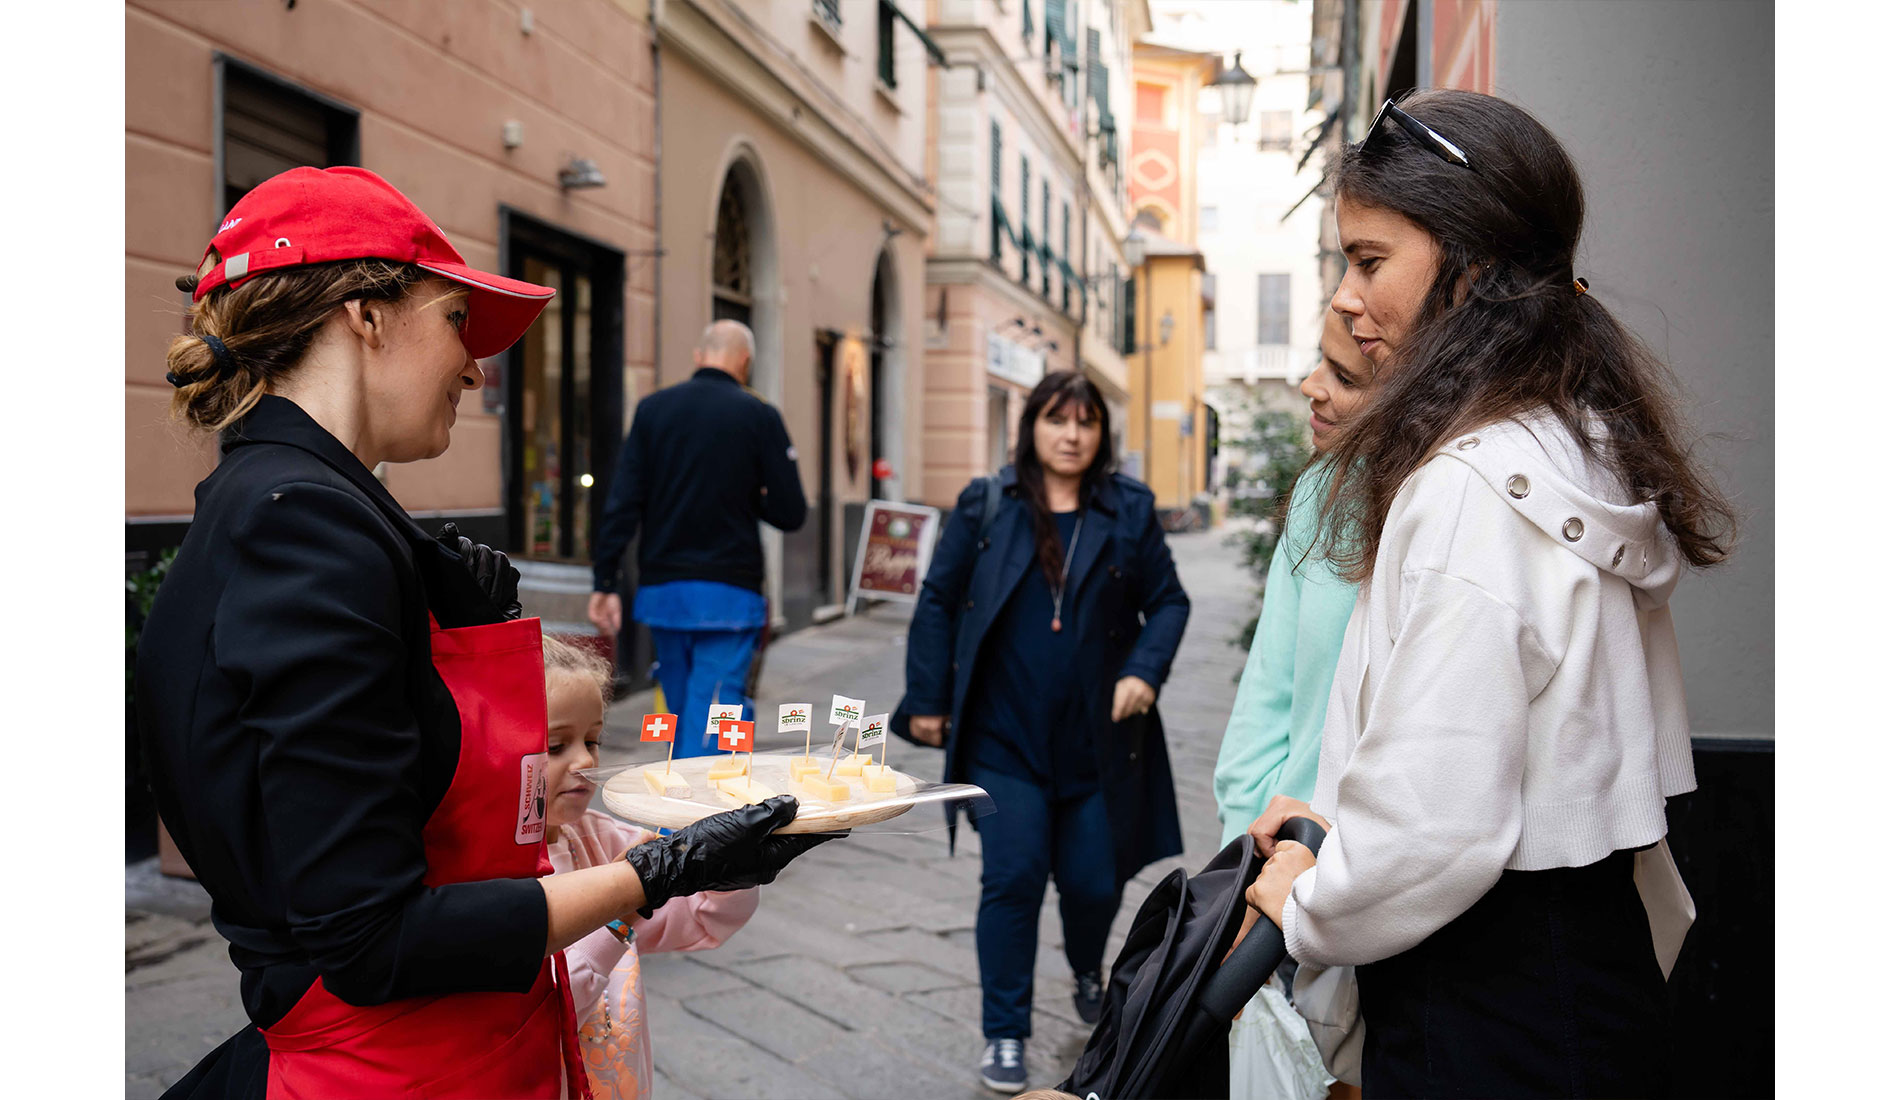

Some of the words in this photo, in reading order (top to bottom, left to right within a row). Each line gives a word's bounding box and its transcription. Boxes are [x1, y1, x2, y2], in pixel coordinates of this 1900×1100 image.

[782, 716, 806, 724] sbrinz
[835, 710, 858, 720] sbrinz
[862, 730, 882, 740] sbrinz
[524, 764, 533, 810] SCHWEIZ
